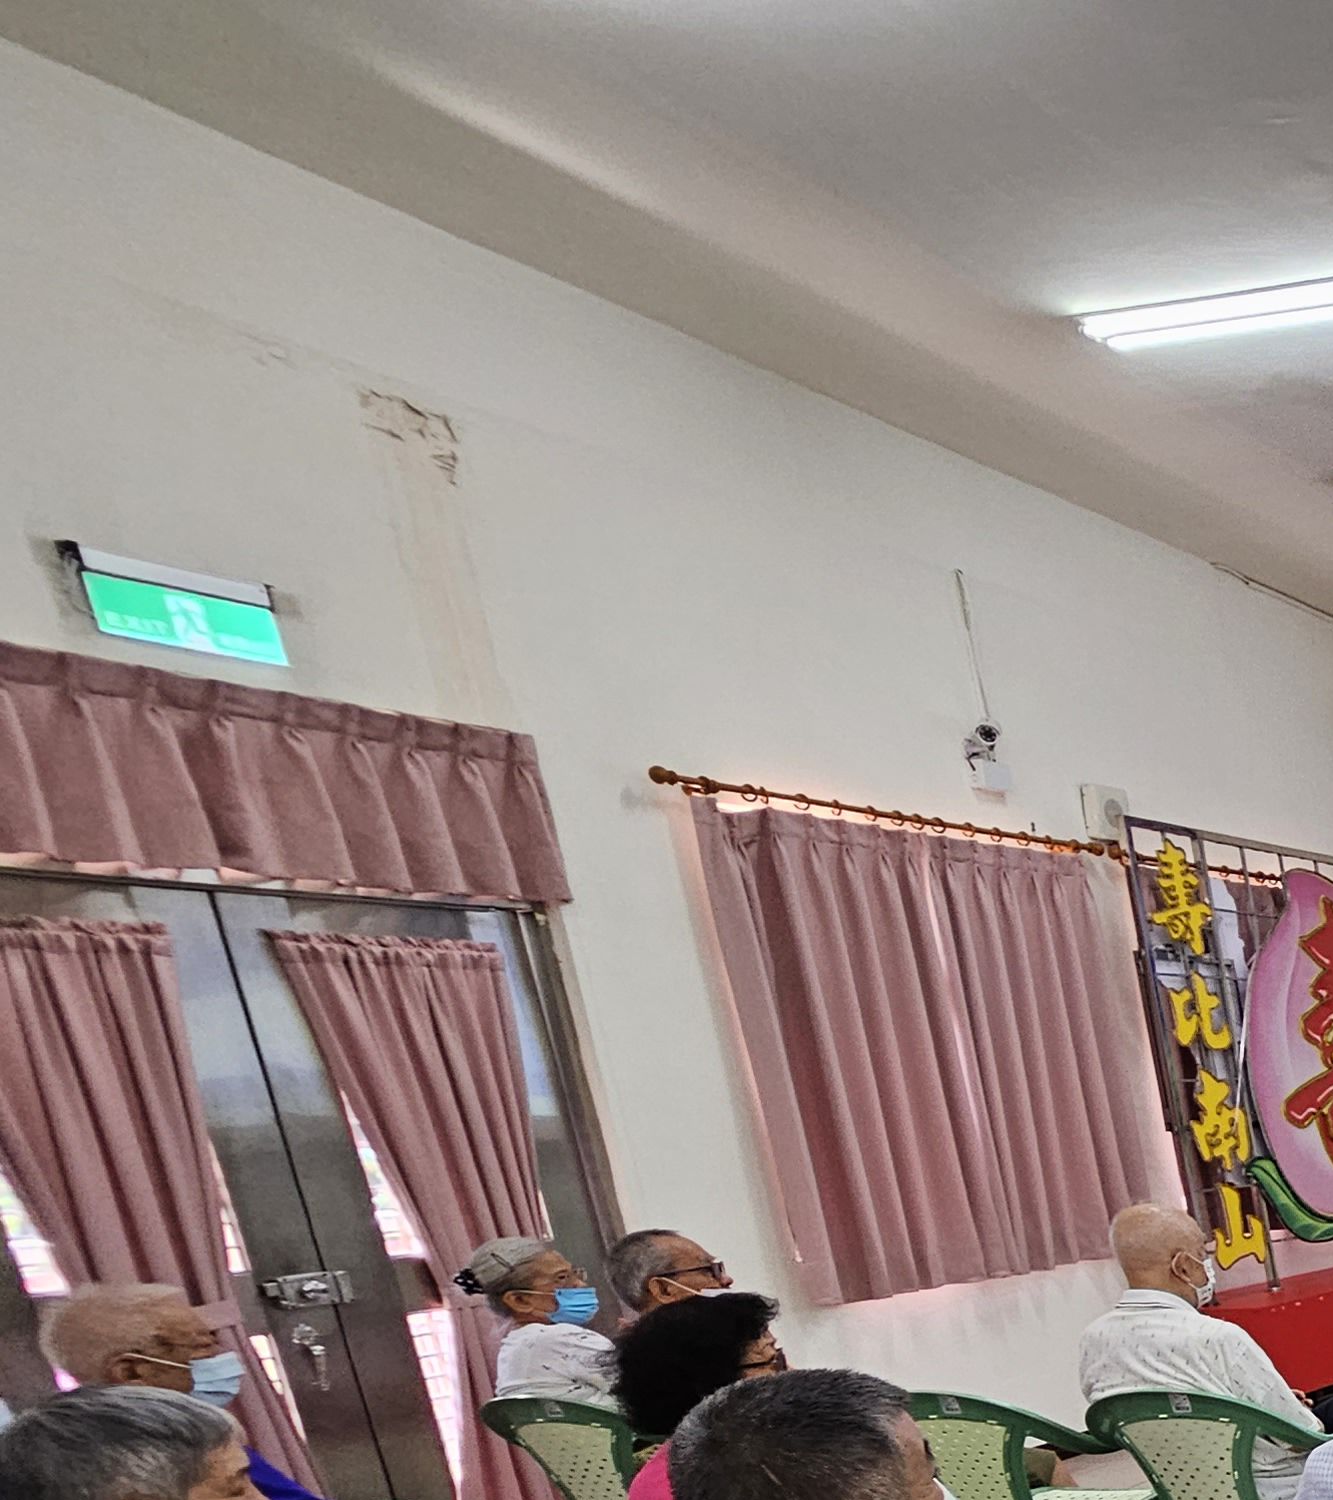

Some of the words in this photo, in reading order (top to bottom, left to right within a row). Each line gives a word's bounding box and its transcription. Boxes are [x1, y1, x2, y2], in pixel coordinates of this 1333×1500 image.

[104, 611, 169, 636] EXIT
[1152, 838, 1268, 1270] 壽比南山
